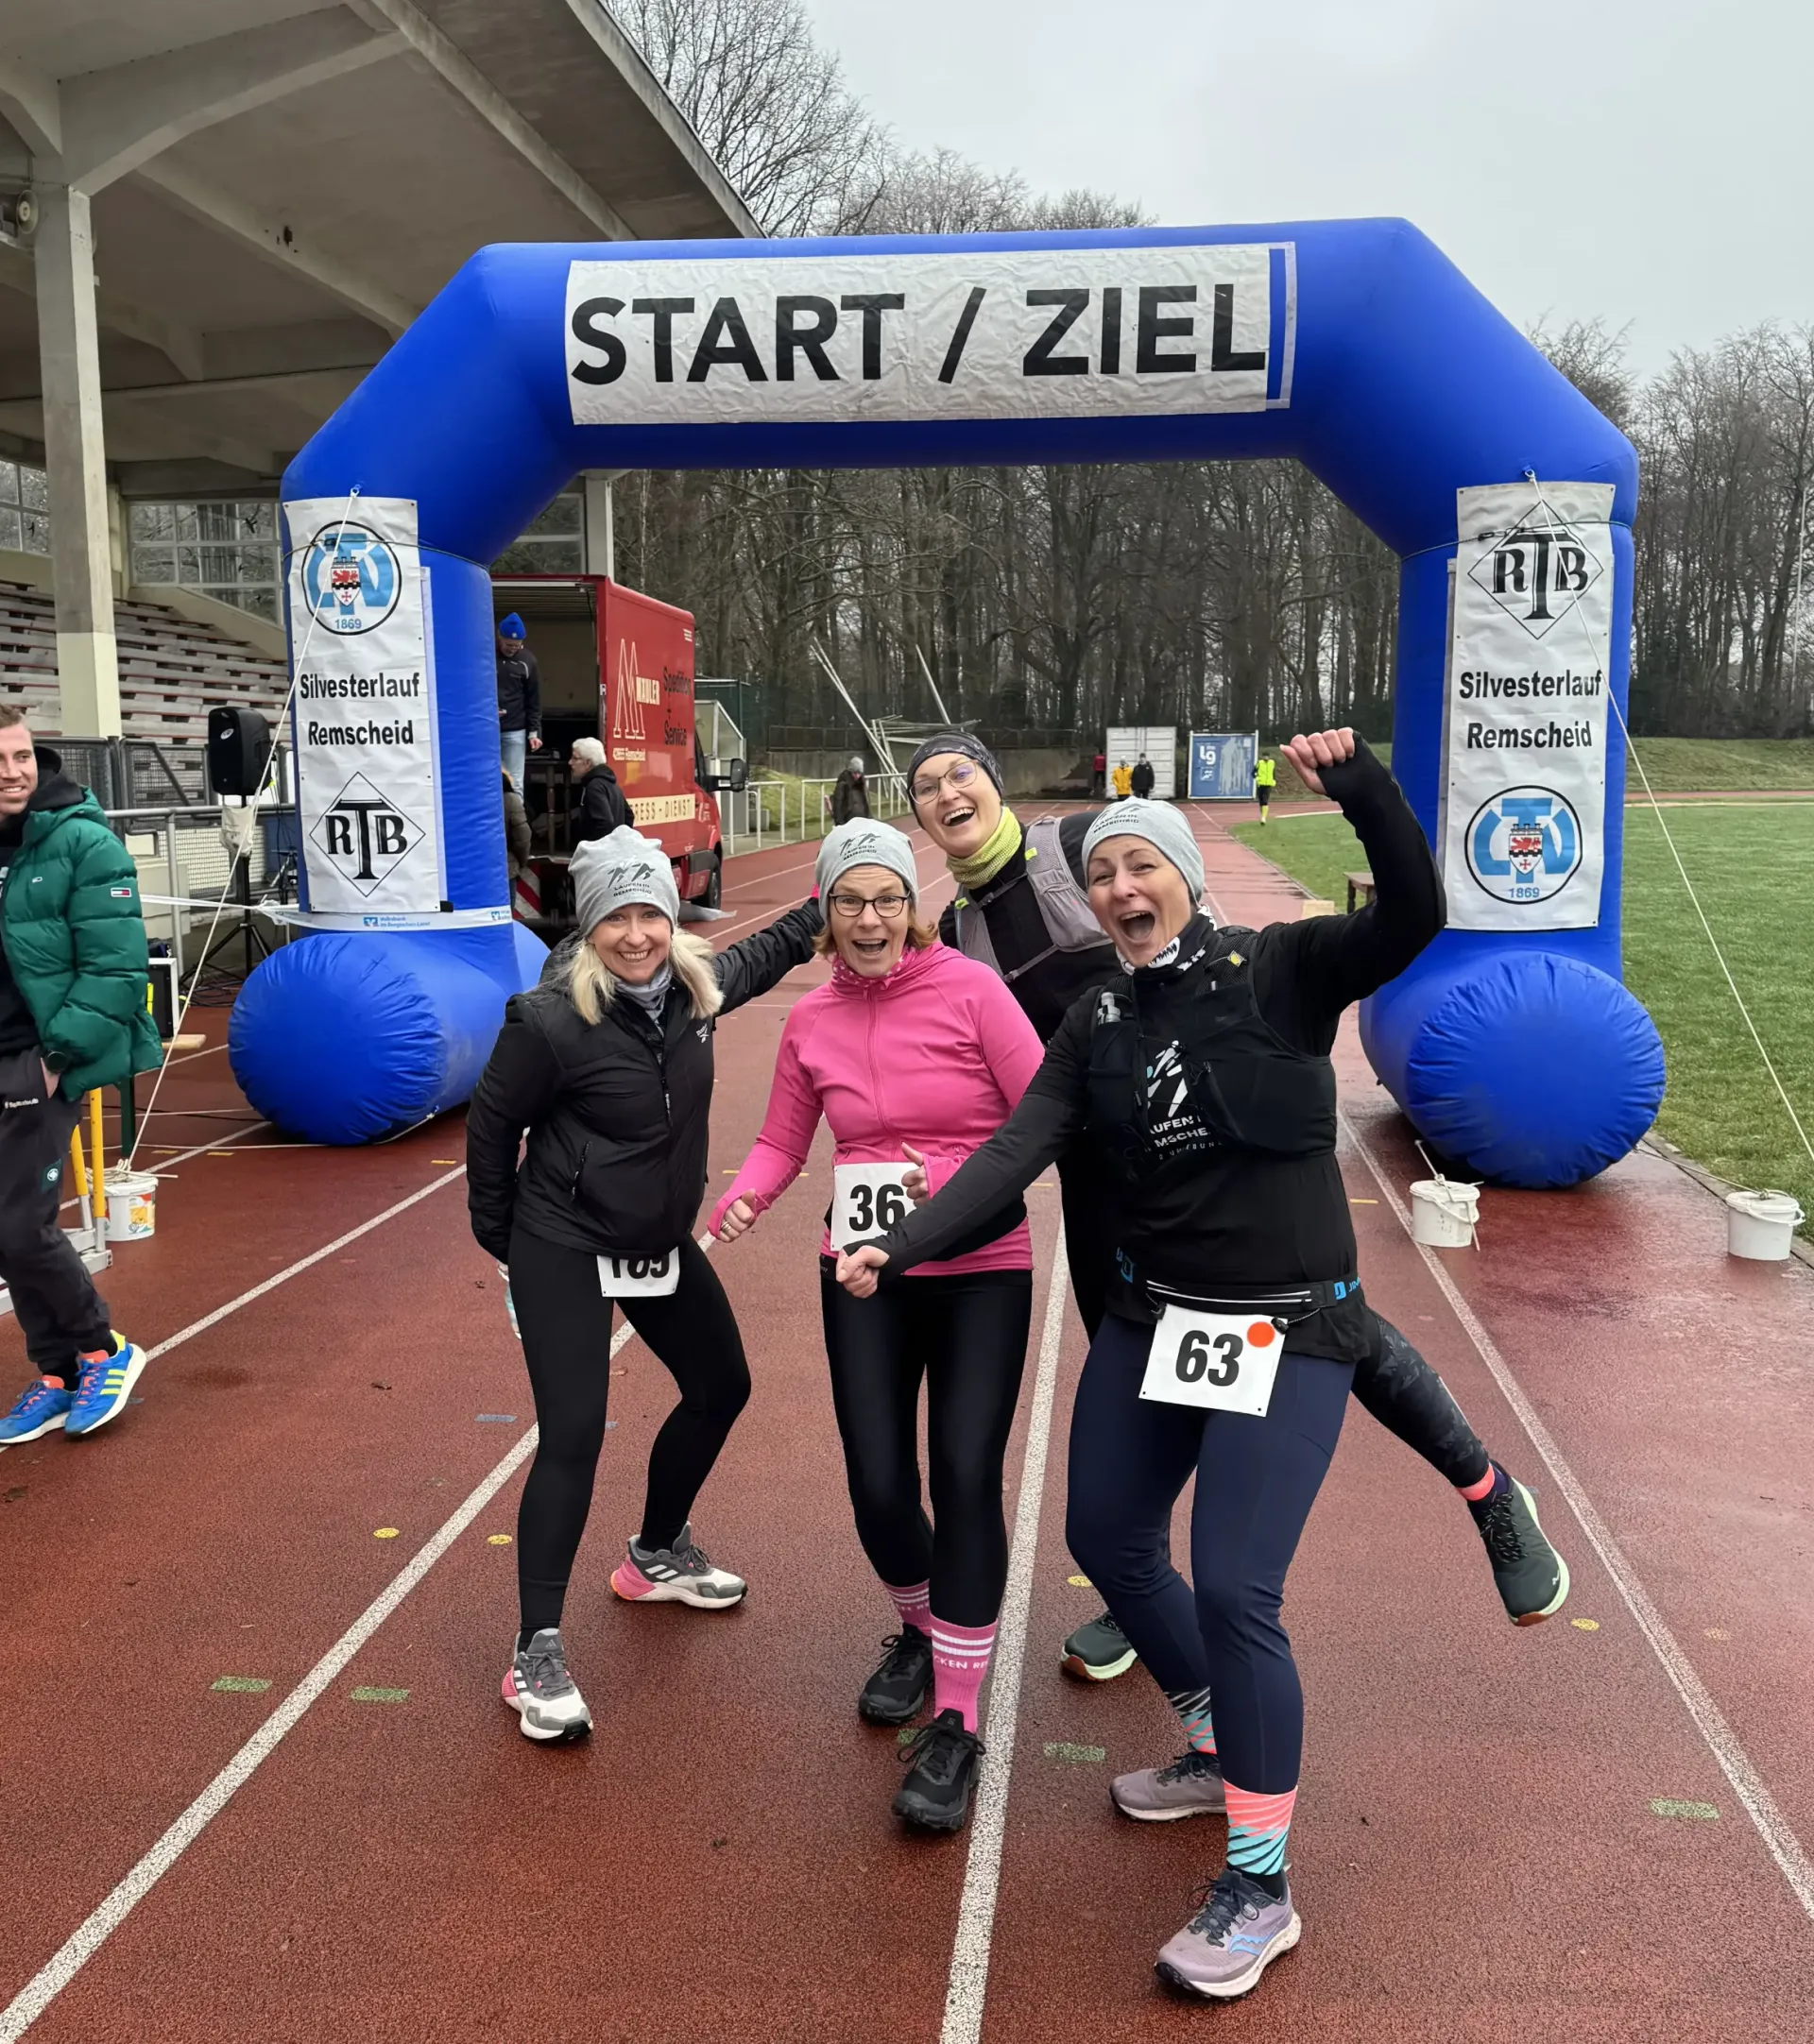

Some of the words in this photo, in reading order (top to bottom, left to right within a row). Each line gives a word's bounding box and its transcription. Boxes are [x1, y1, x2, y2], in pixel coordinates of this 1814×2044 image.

[570, 292, 904, 385] START
[937, 286, 987, 384] /
[1023, 283, 1266, 378] ZIEL
[335, 619, 362, 630] 1869
[300, 672, 419, 699] Silvesterlauf
[1460, 670, 1600, 698] Silvesterlauf
[308, 720, 415, 745] Remscheid
[1467, 721, 1592, 749] Remscheid
[630, 802, 656, 821] RESS
[665, 798, 692, 818] DIENST
[326, 798, 408, 880] RTB
[1509, 887, 1540, 898] 1869
[1150, 1116, 1194, 1134] UFEN
[1155, 1127, 1210, 1148] MSCHE
[848, 1184, 905, 1232] 36
[1174, 1330, 1243, 1387] 63
